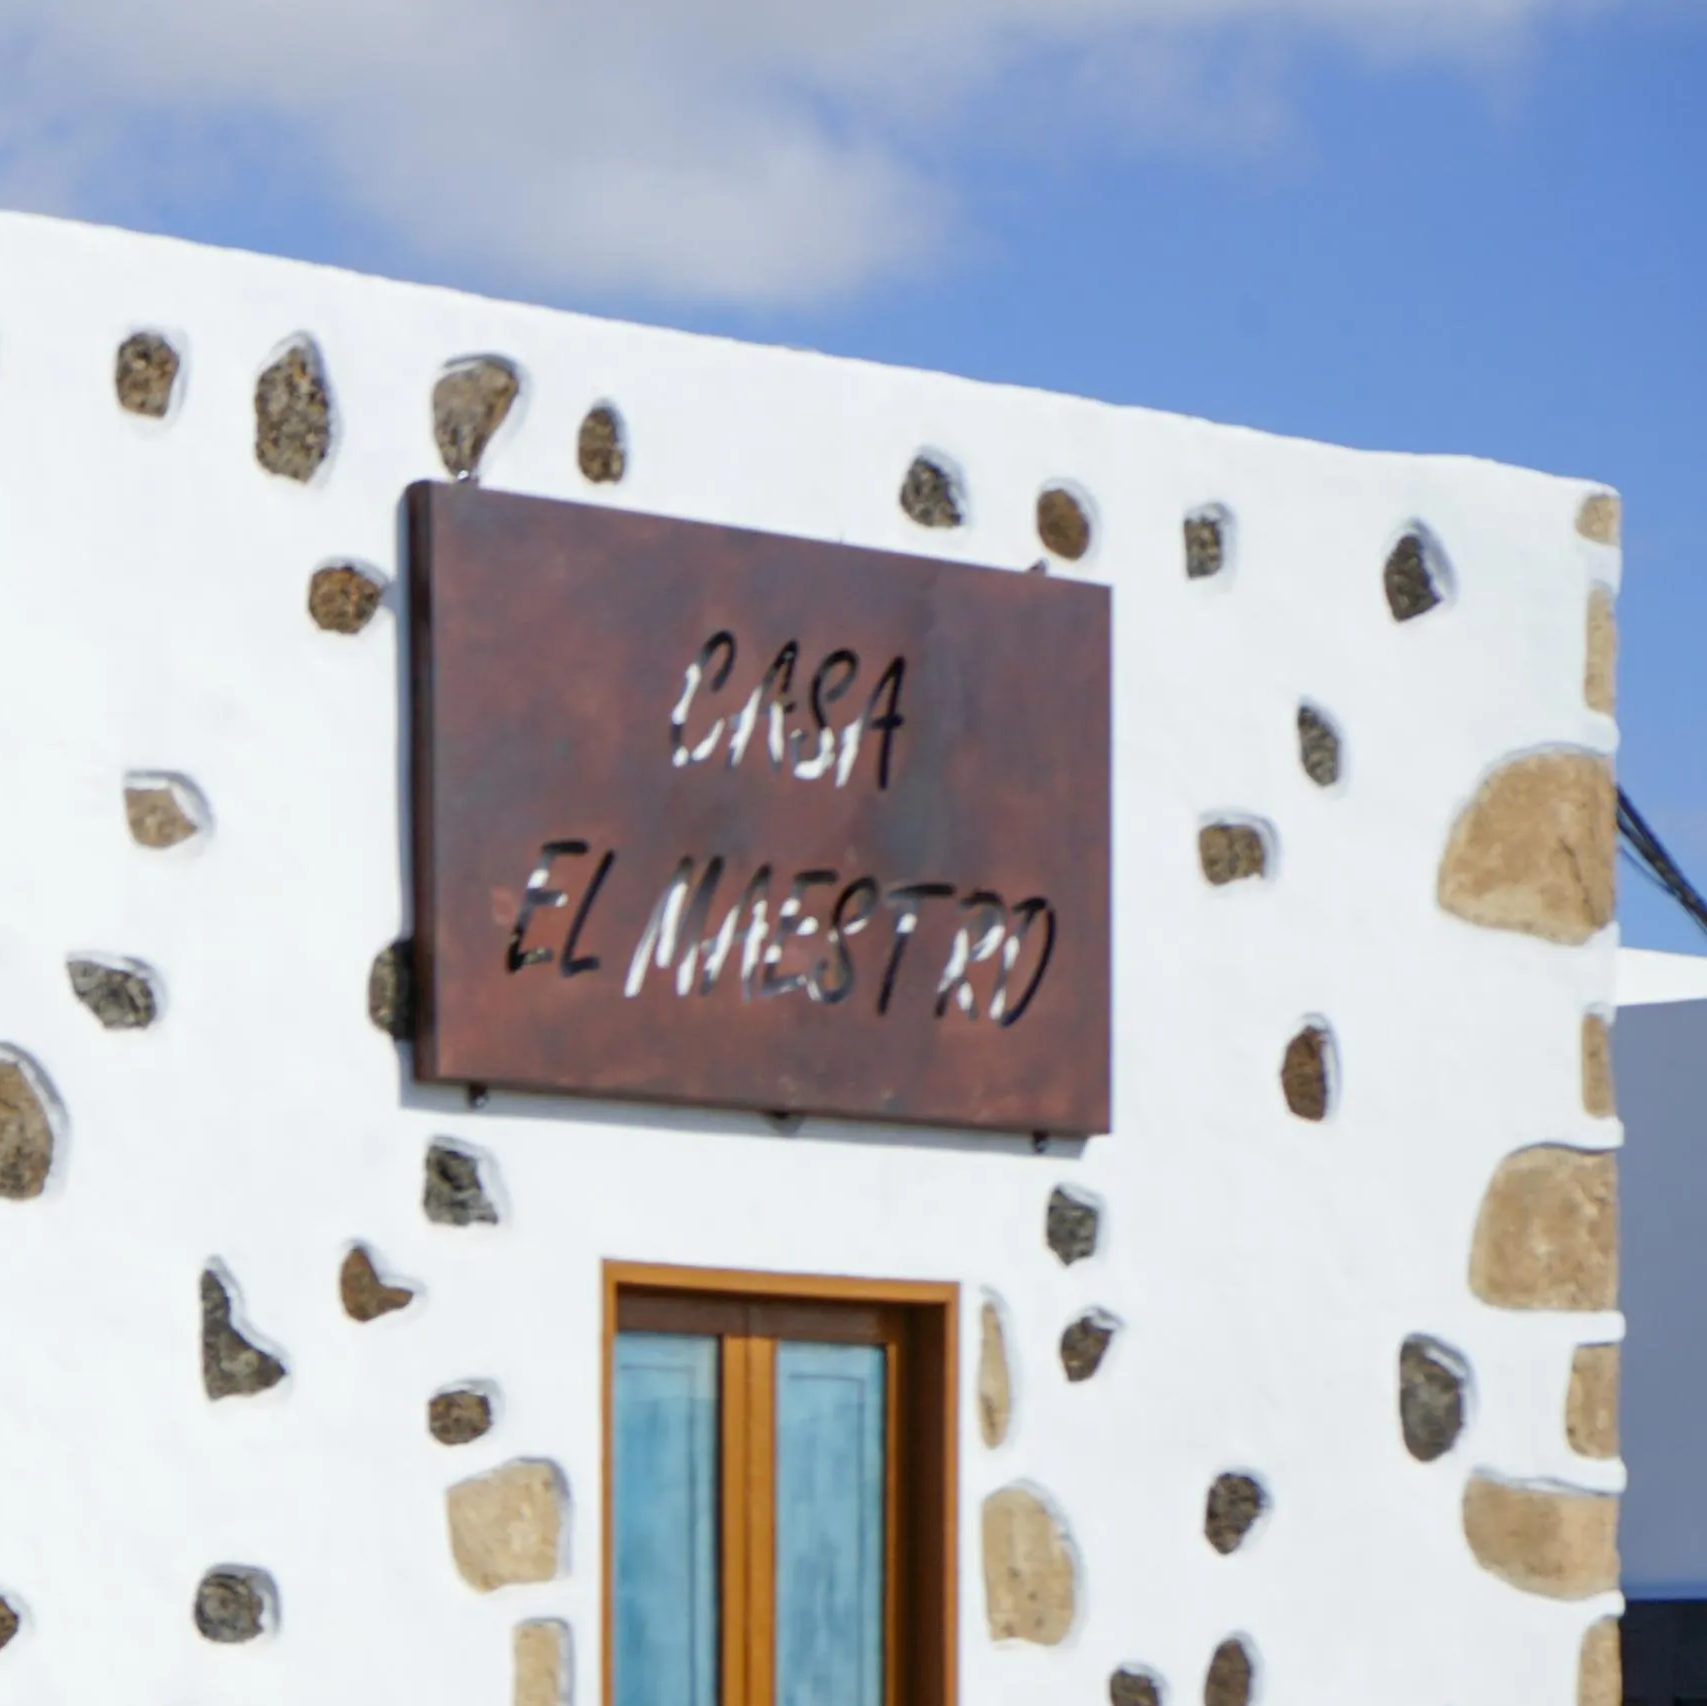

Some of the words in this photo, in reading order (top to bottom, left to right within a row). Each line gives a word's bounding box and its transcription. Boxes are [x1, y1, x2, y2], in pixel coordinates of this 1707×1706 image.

[670, 630, 907, 790] CASA
[506, 838, 617, 977] EL
[624, 856, 1057, 1027] MAESTRO
